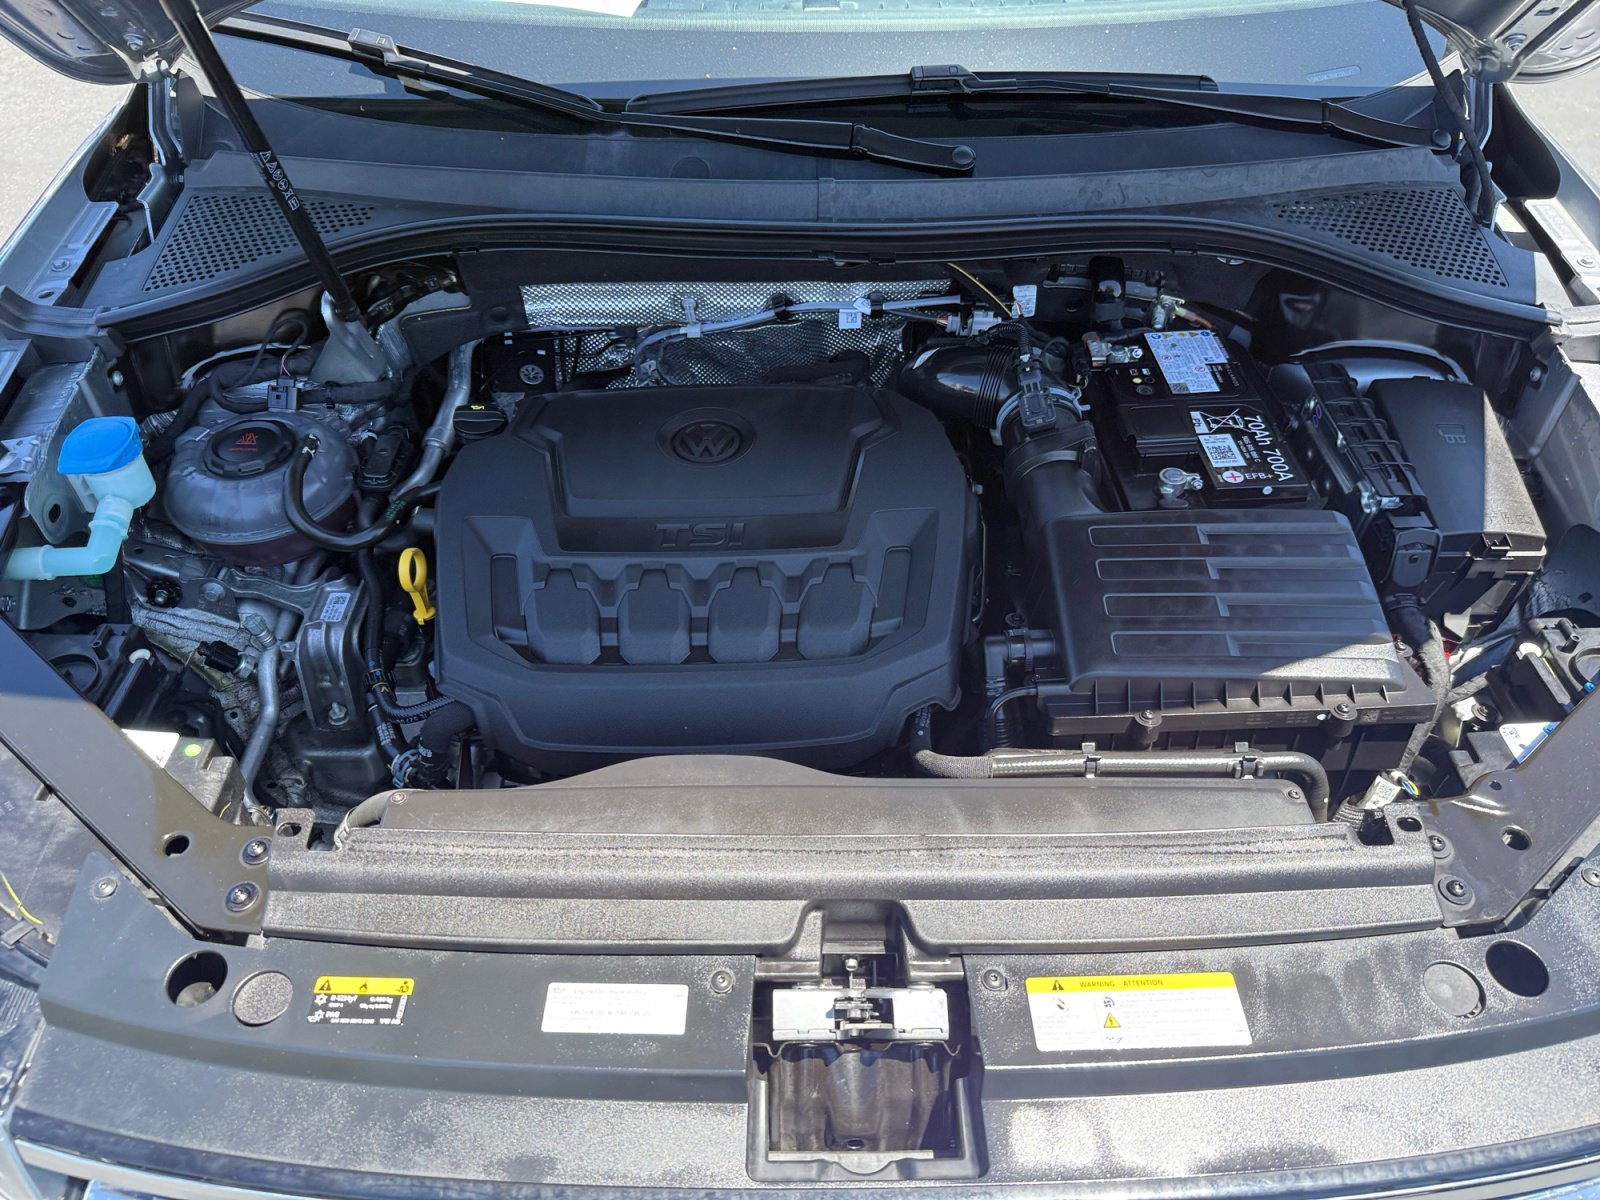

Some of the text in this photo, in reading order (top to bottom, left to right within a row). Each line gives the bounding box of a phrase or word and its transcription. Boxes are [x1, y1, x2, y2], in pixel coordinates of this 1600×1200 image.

[1192, 417, 1202, 427] Pb
[1244, 415, 1273, 446] 70Ah
[1262, 448, 1295, 482] 700A
[655, 522, 746, 547] TSI
[1123, 979, 1163, 987] ATTENTION
